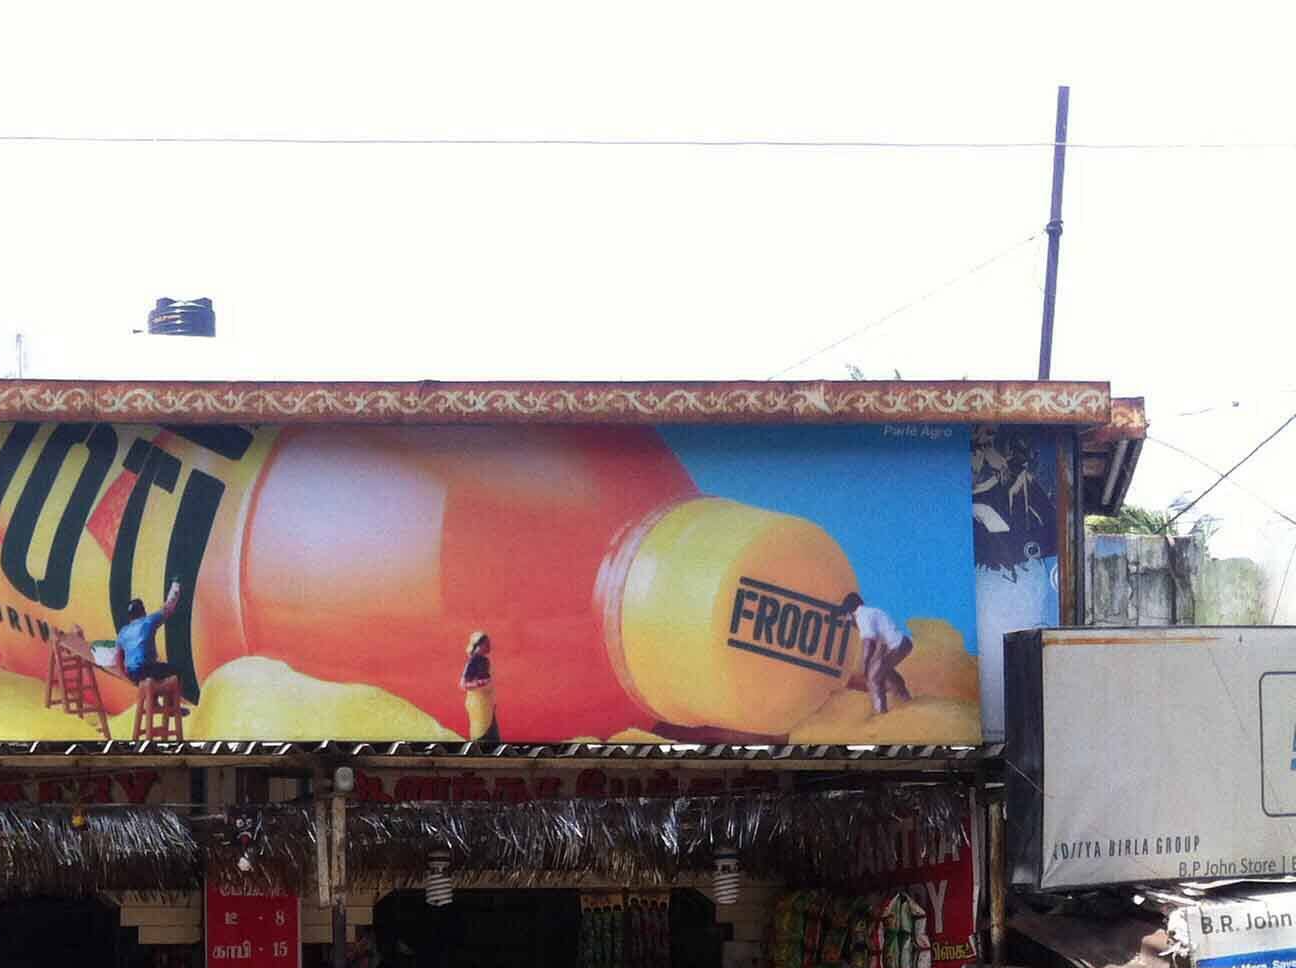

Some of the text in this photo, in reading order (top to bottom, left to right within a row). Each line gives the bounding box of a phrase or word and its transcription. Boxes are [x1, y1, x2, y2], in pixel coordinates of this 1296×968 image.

[729, 587, 854, 666] FROOTI
[1108, 838, 1150, 857] BIRLA
[1156, 835, 1201, 855] GROUP
[1203, 860, 1238, 876] John
[1240, 857, 1277, 874] Store
[1245, 911, 1293, 931] John
[212, 940, 289, 959] காபி 15
